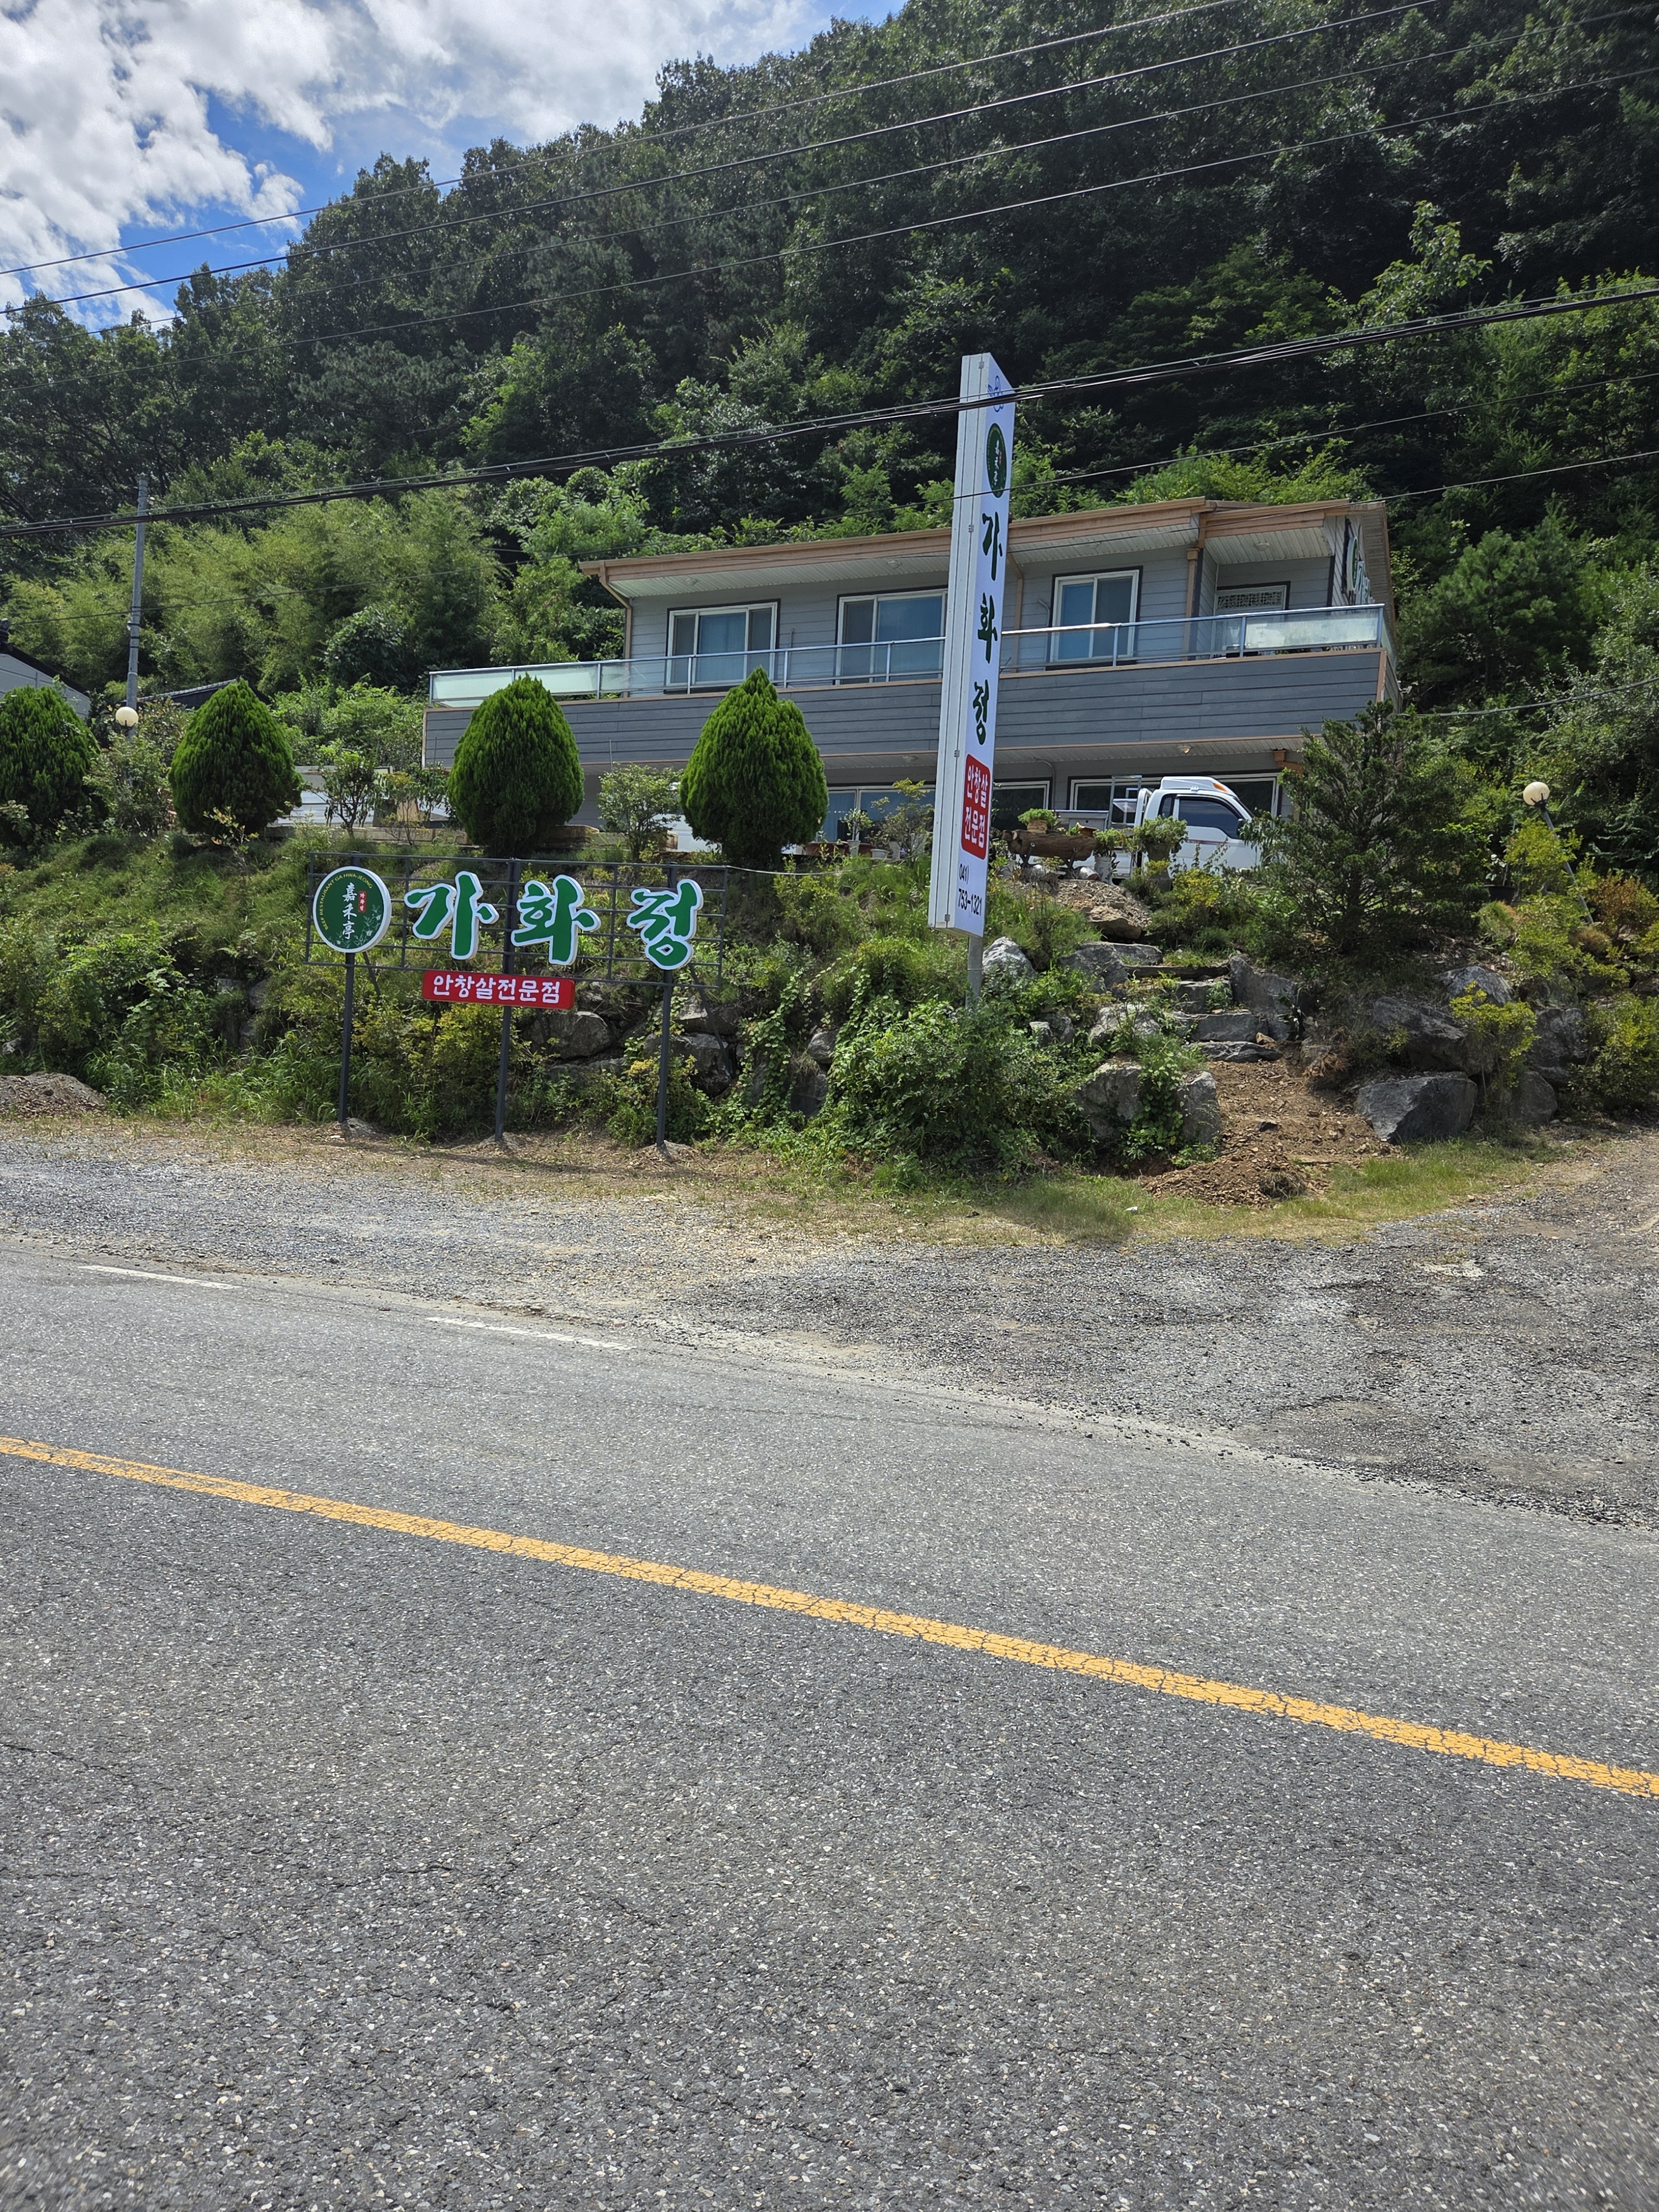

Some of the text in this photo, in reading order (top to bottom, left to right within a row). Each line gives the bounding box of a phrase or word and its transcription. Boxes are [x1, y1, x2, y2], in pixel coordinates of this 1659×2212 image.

[973, 512, 1003, 745] 가화정
[967, 765, 988, 808] 안창살
[964, 807, 985, 848] 전문점
[319, 879, 335, 916] RESTAURANT
[343, 873, 373, 889] HWA-JEONG
[342, 882, 357, 940] 嘉禾亭
[958, 888, 982, 916] 753-1321
[404, 871, 704, 970] 가화정
[433, 974, 560, 1004] 안창살전문점
